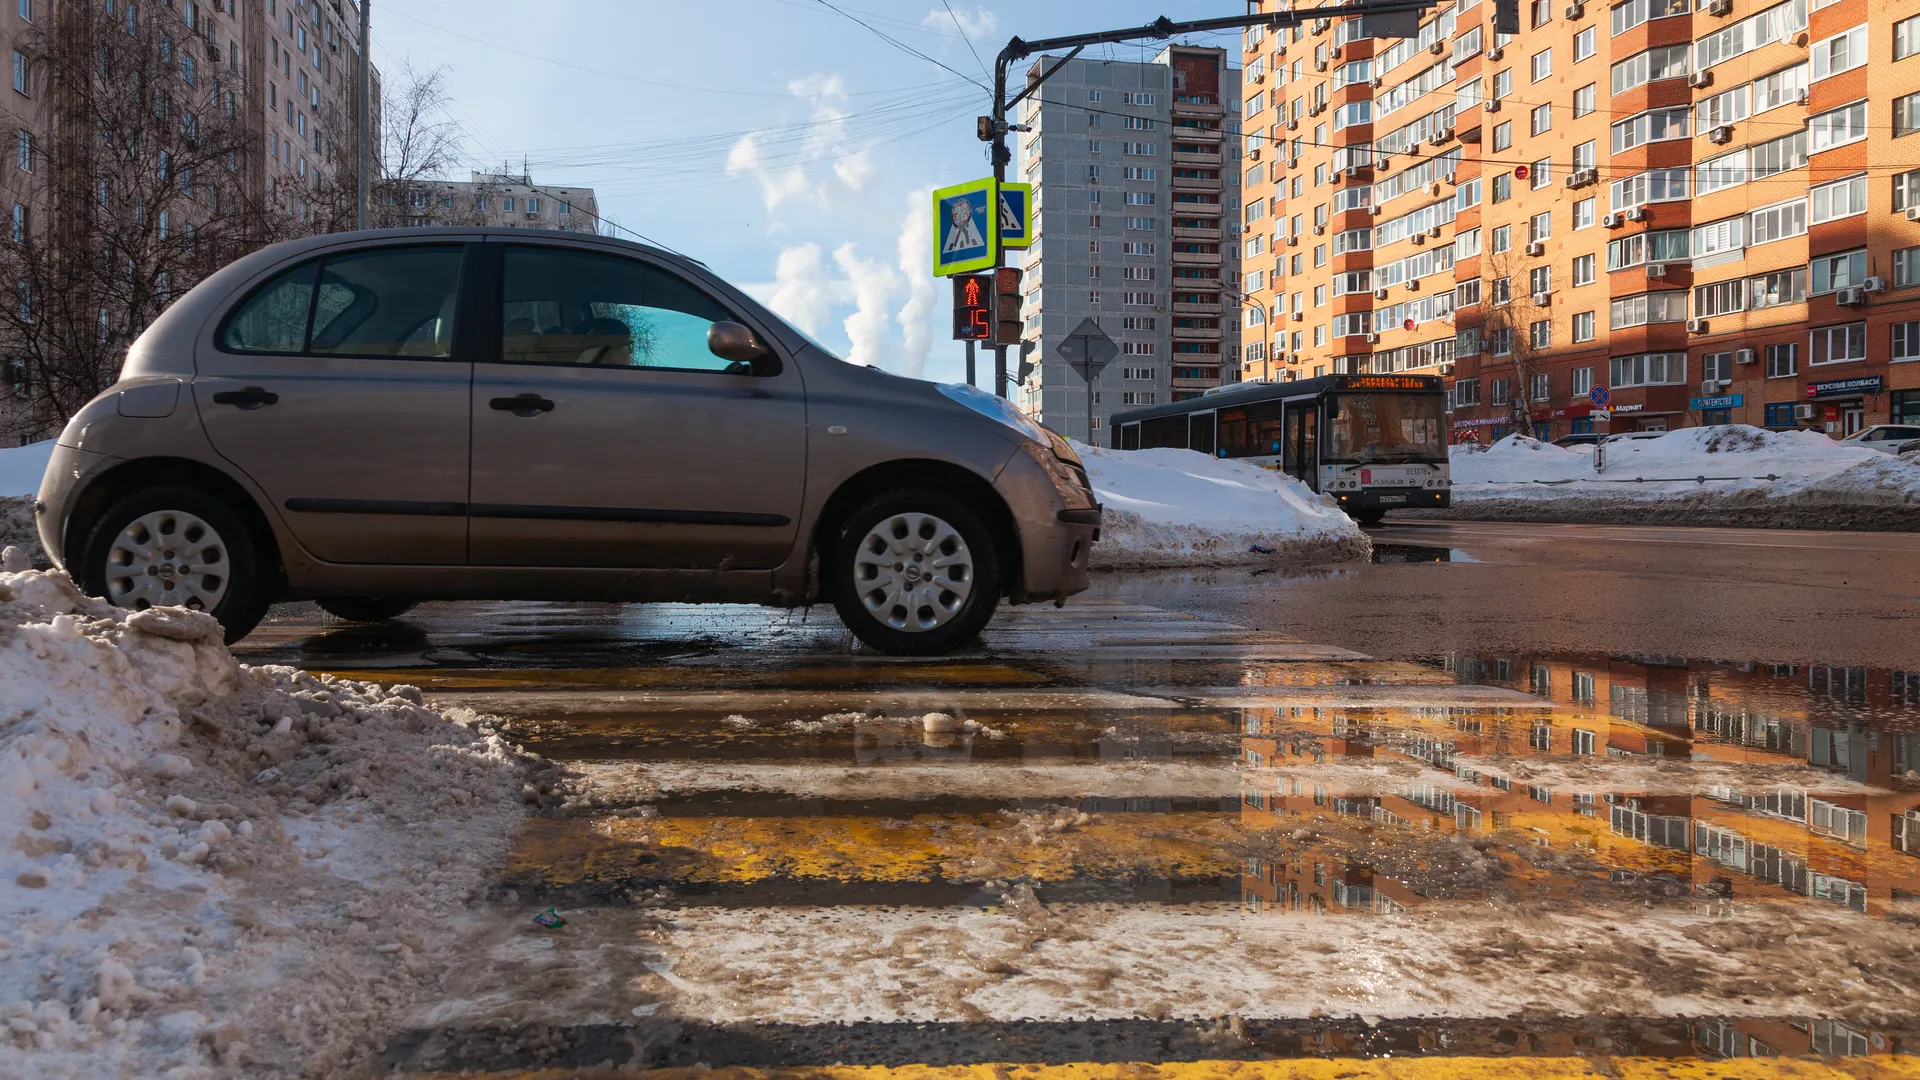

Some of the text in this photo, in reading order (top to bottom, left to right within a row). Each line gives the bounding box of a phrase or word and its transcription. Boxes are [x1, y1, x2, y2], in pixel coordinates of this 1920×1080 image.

[971, 310, 989, 337] 15
[1816, 382, 1846, 391] ВКУСНЫЕ
[1847, 378, 1880, 388] КОЛБАСЫ
[1615, 404, 1643, 412] Маркет
[1405, 468, 1428, 476] 013278
